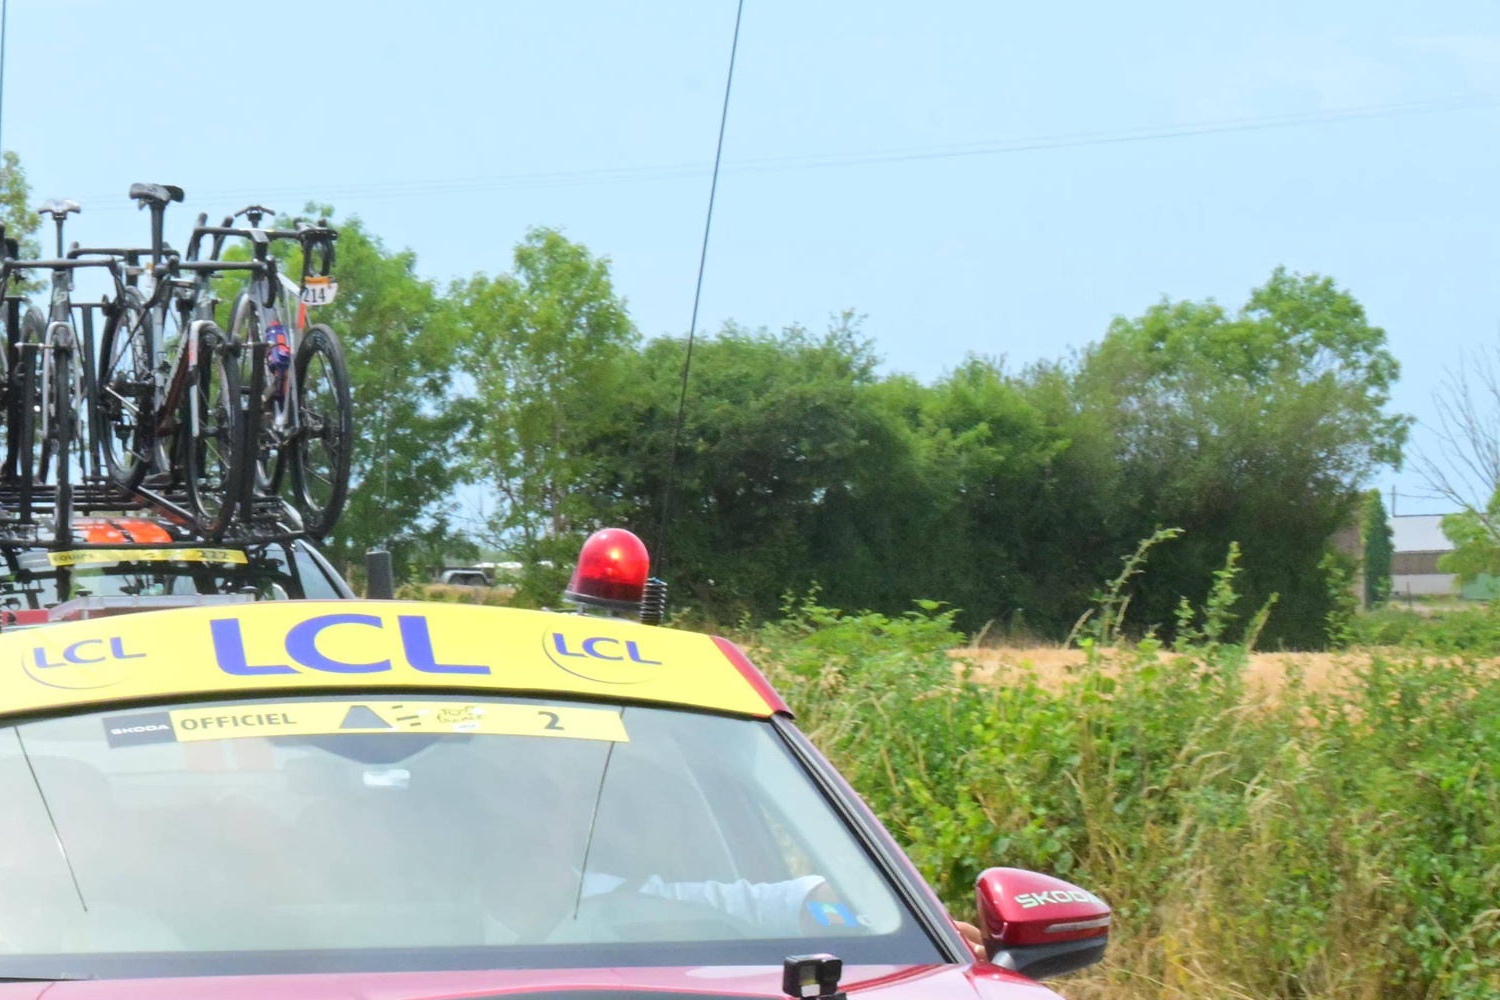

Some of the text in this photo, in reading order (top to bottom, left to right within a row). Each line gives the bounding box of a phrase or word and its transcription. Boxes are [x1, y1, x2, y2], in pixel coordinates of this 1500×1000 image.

[33, 637, 147, 669] LCL
[211, 614, 490, 676] LCL
[553, 633, 662, 666] LCL
[110, 723, 171, 735] SKODA
[180, 713, 297, 731] OFFICIEL
[538, 711, 565, 731] 2
